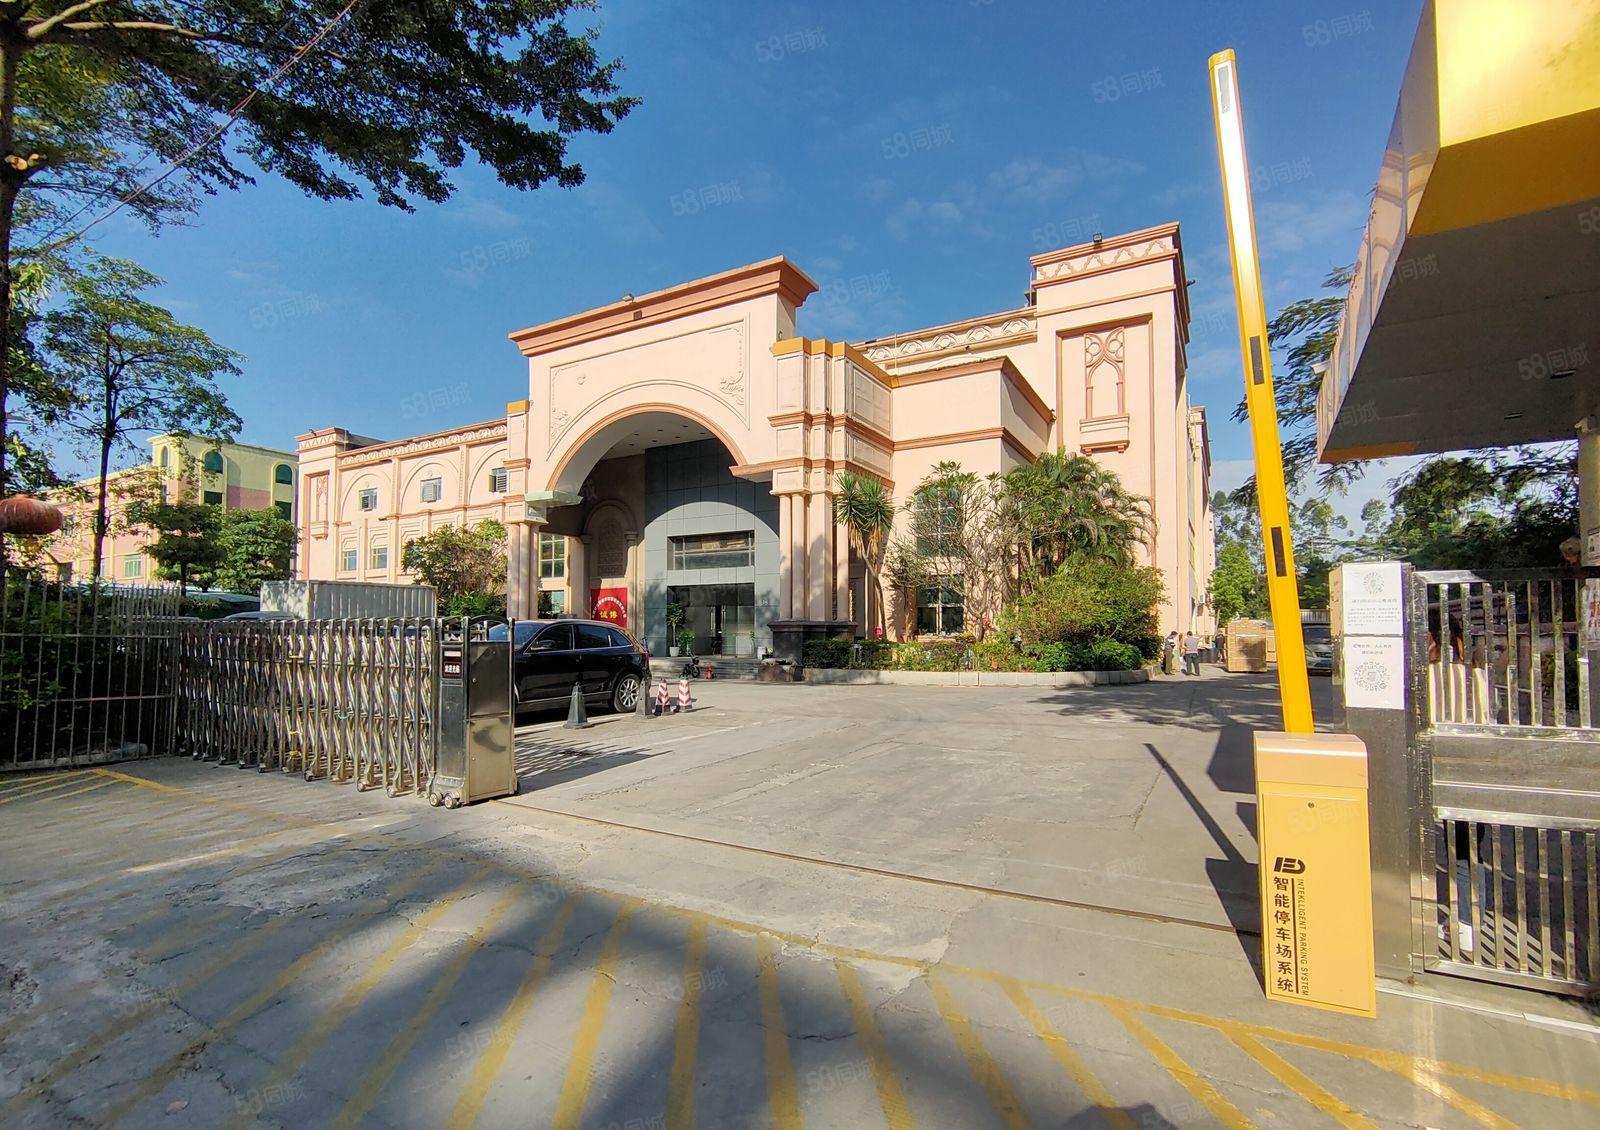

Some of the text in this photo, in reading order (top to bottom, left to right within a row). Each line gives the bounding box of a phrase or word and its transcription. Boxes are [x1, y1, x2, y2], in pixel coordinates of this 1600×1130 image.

[1273, 876, 1294, 993] 智能停车场系统
[1299, 932, 1308, 965] PARKING
[1301, 967, 1310, 996] SYSTEM
